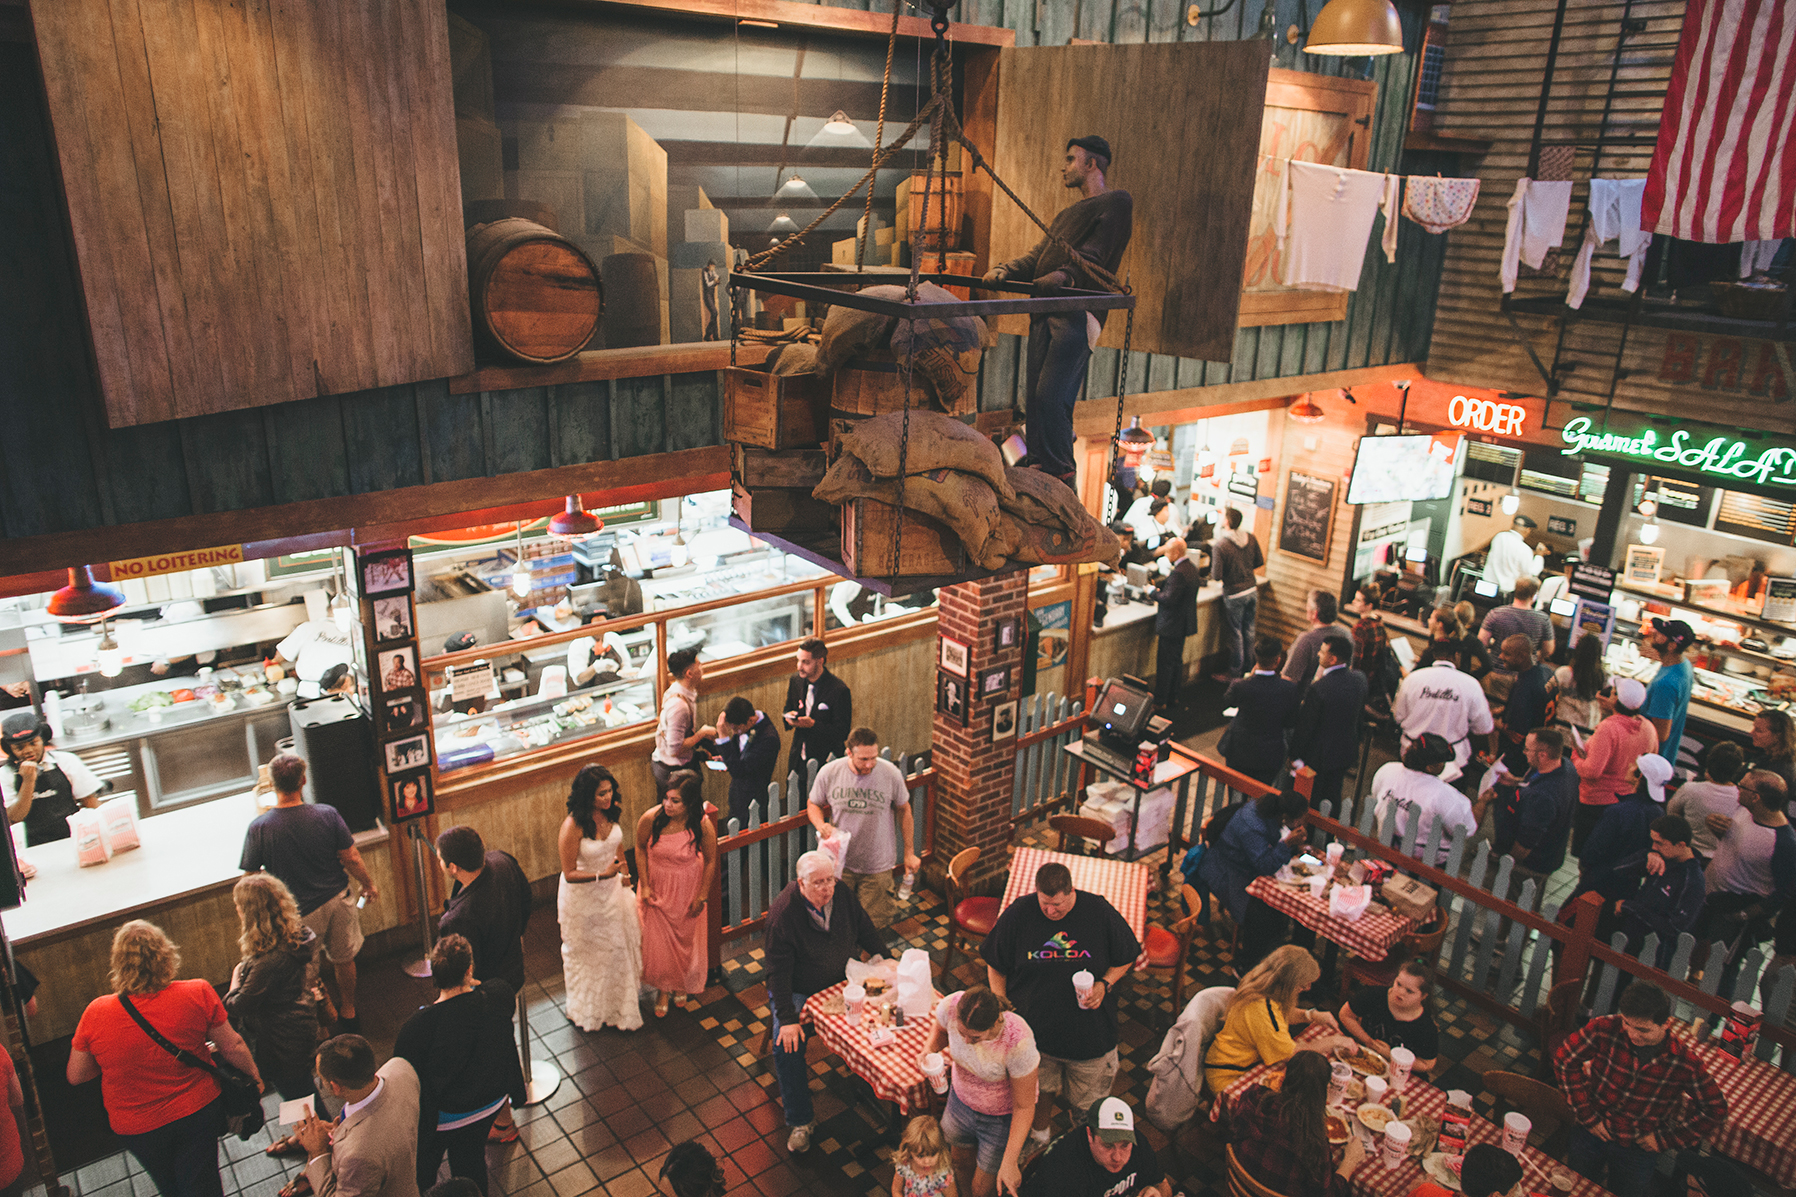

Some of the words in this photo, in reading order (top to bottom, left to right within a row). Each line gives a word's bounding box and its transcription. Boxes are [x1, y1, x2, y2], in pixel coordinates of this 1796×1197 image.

[1448, 396, 1526, 436] ORDER
[1561, 417, 1656, 455] Gourmet
[114, 562, 144, 577] NO
[148, 548, 239, 571] LOITERING
[832, 786, 885, 804] GUINNESS
[1027, 949, 1092, 960] KOLOA
